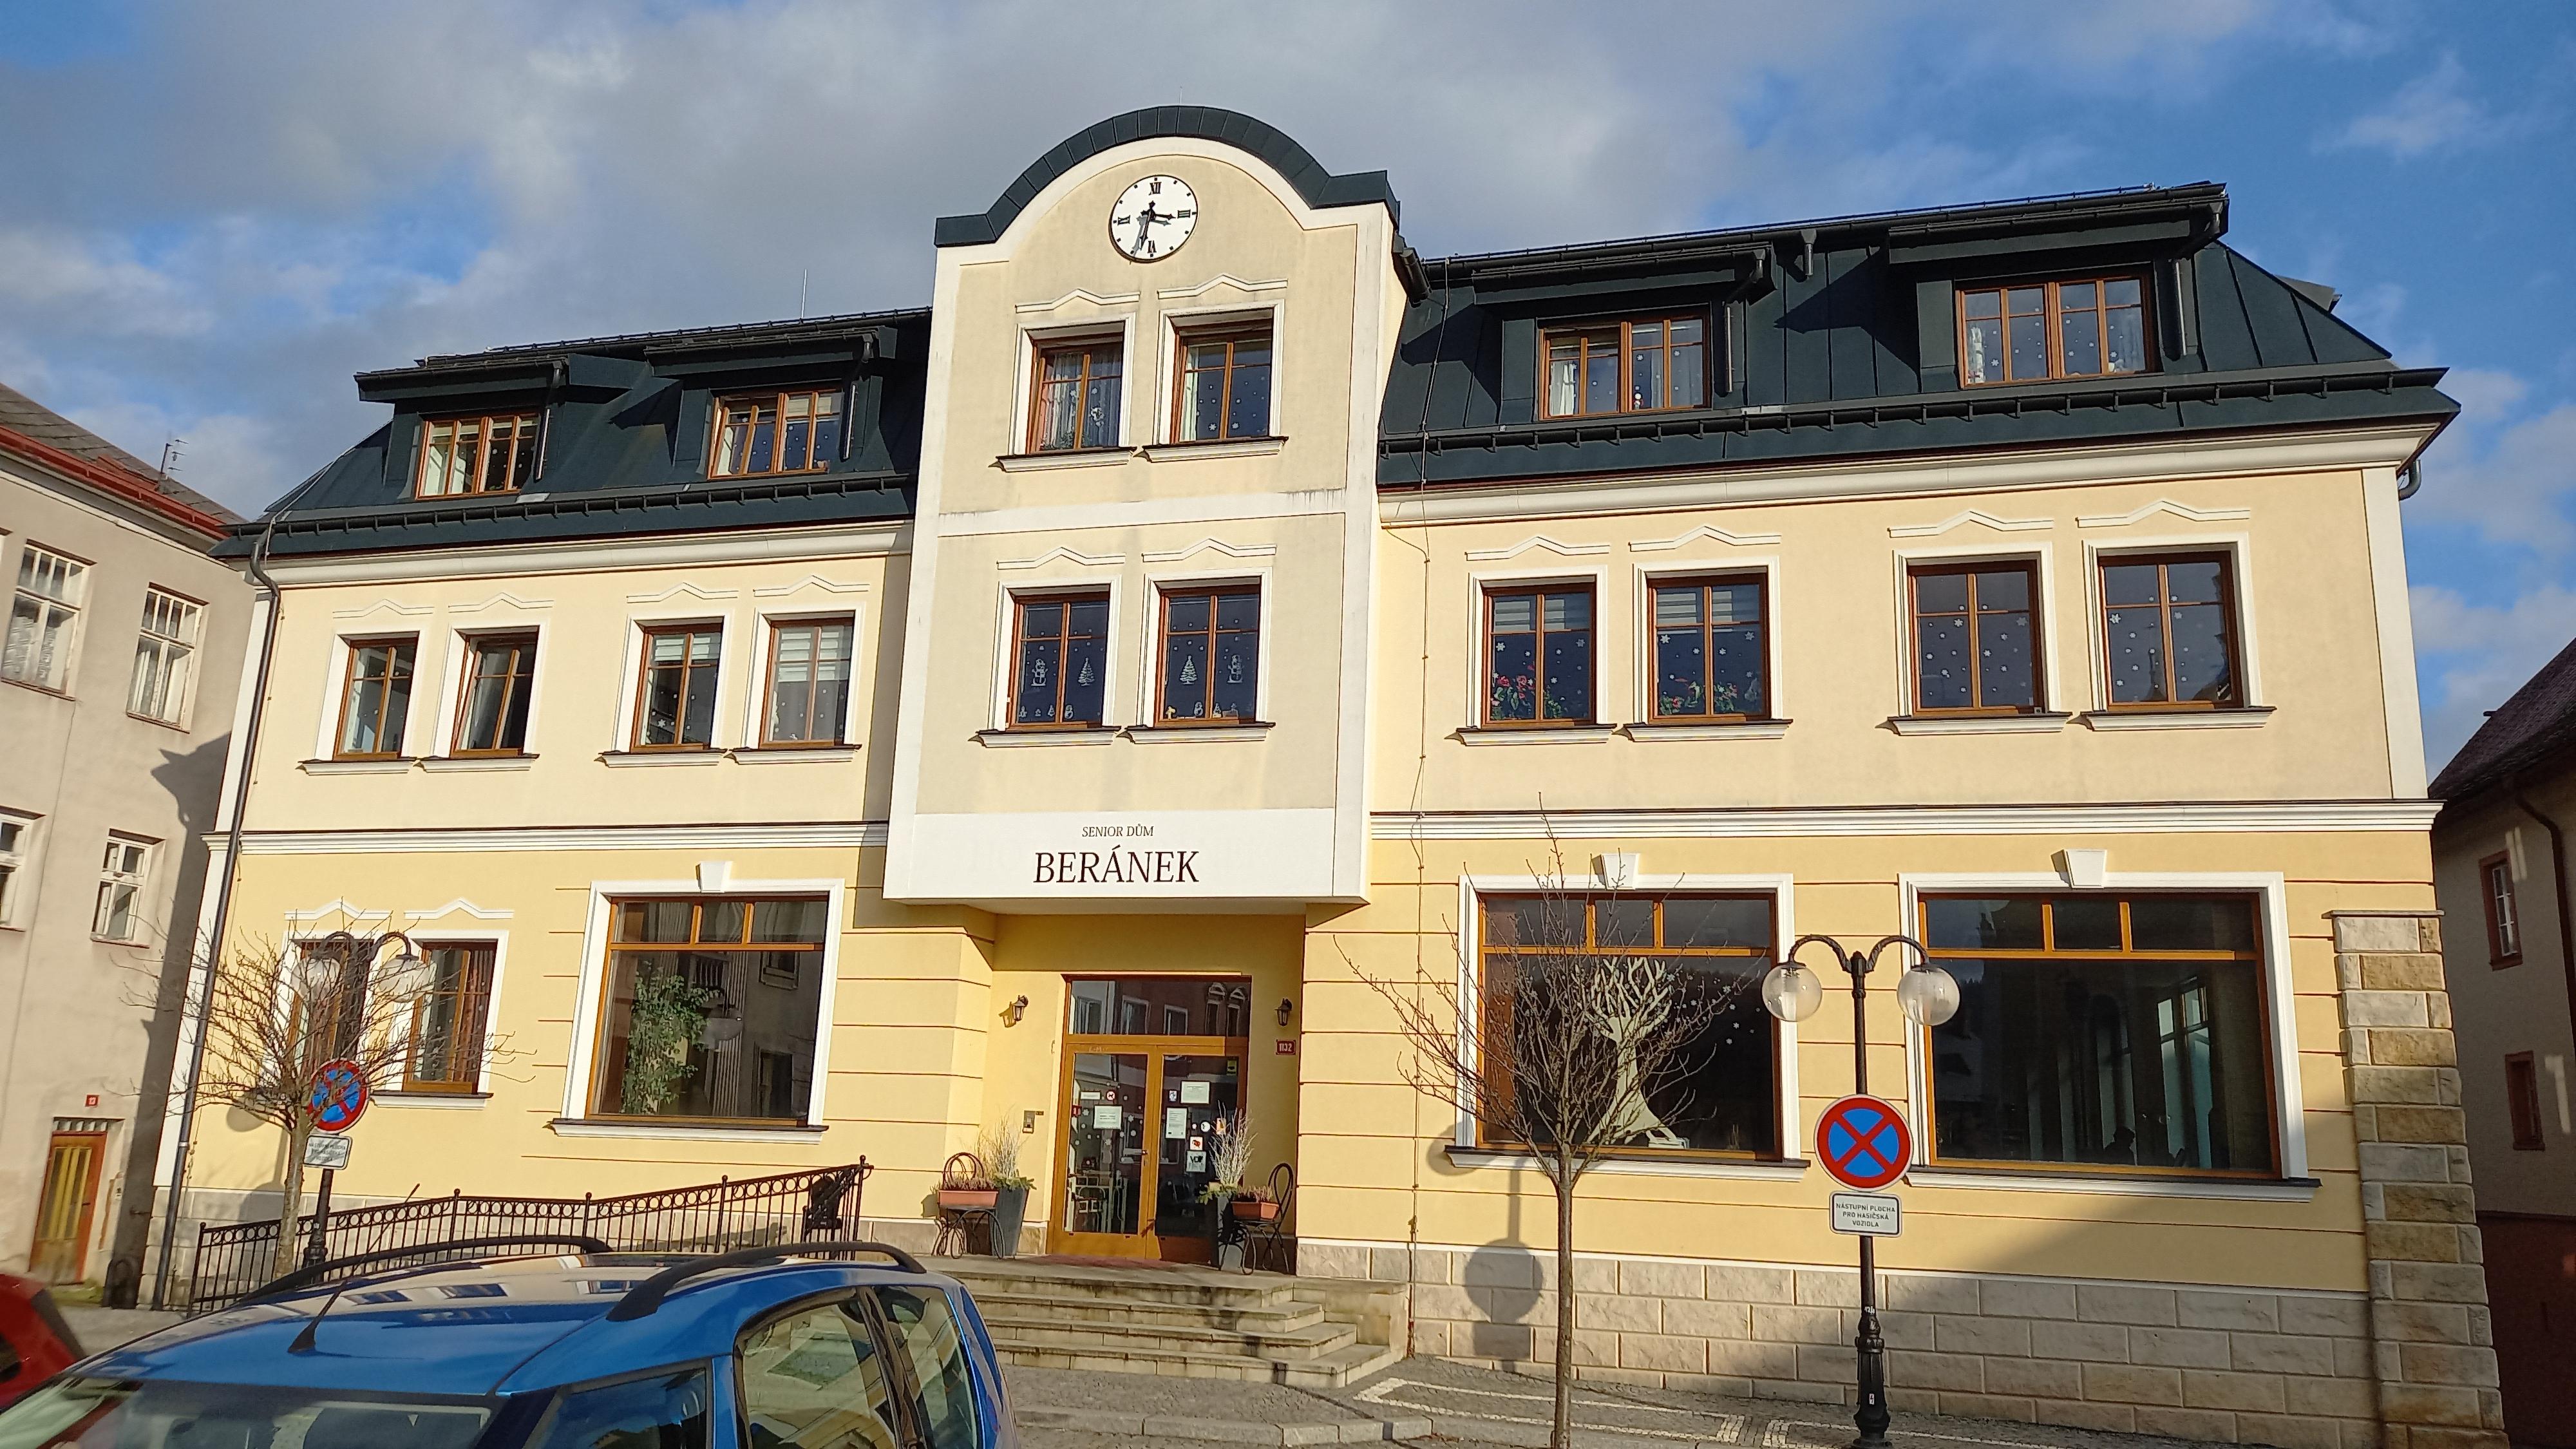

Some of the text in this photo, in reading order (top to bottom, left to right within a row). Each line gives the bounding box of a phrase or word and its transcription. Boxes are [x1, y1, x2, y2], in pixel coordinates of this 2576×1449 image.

[1082, 823, 1154, 837] SENIOR DŮM
[1033, 844, 1199, 883] BERÁNEK
[1836, 1202, 1868, 1211] NÁSTUPNÍ
